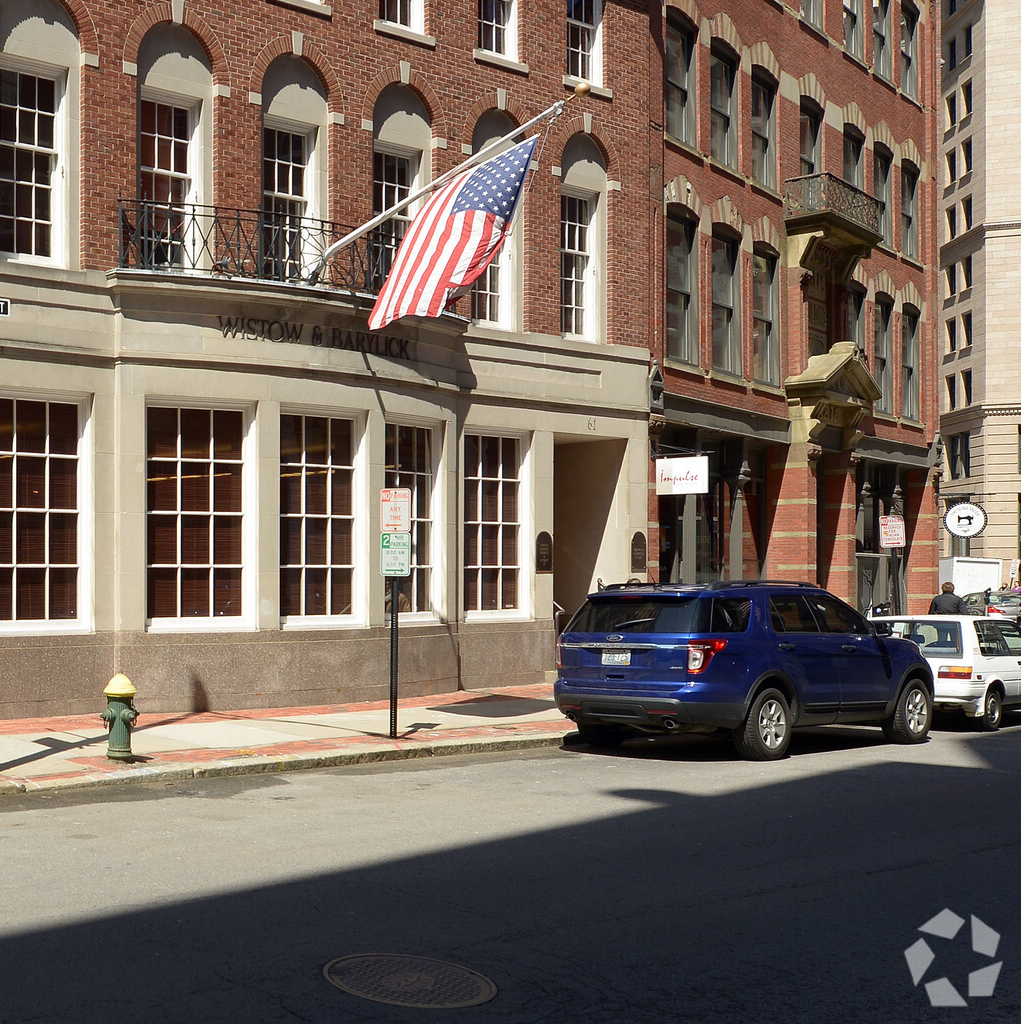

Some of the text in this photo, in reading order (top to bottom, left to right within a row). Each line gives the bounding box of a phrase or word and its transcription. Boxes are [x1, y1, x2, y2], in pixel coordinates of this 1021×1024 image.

[217, 315, 410, 360] WISTOW & BARYLICK
[587, 417, 597, 431] 61
[382, 492, 409, 501] NO PARKING
[382, 534, 390, 546] 2
